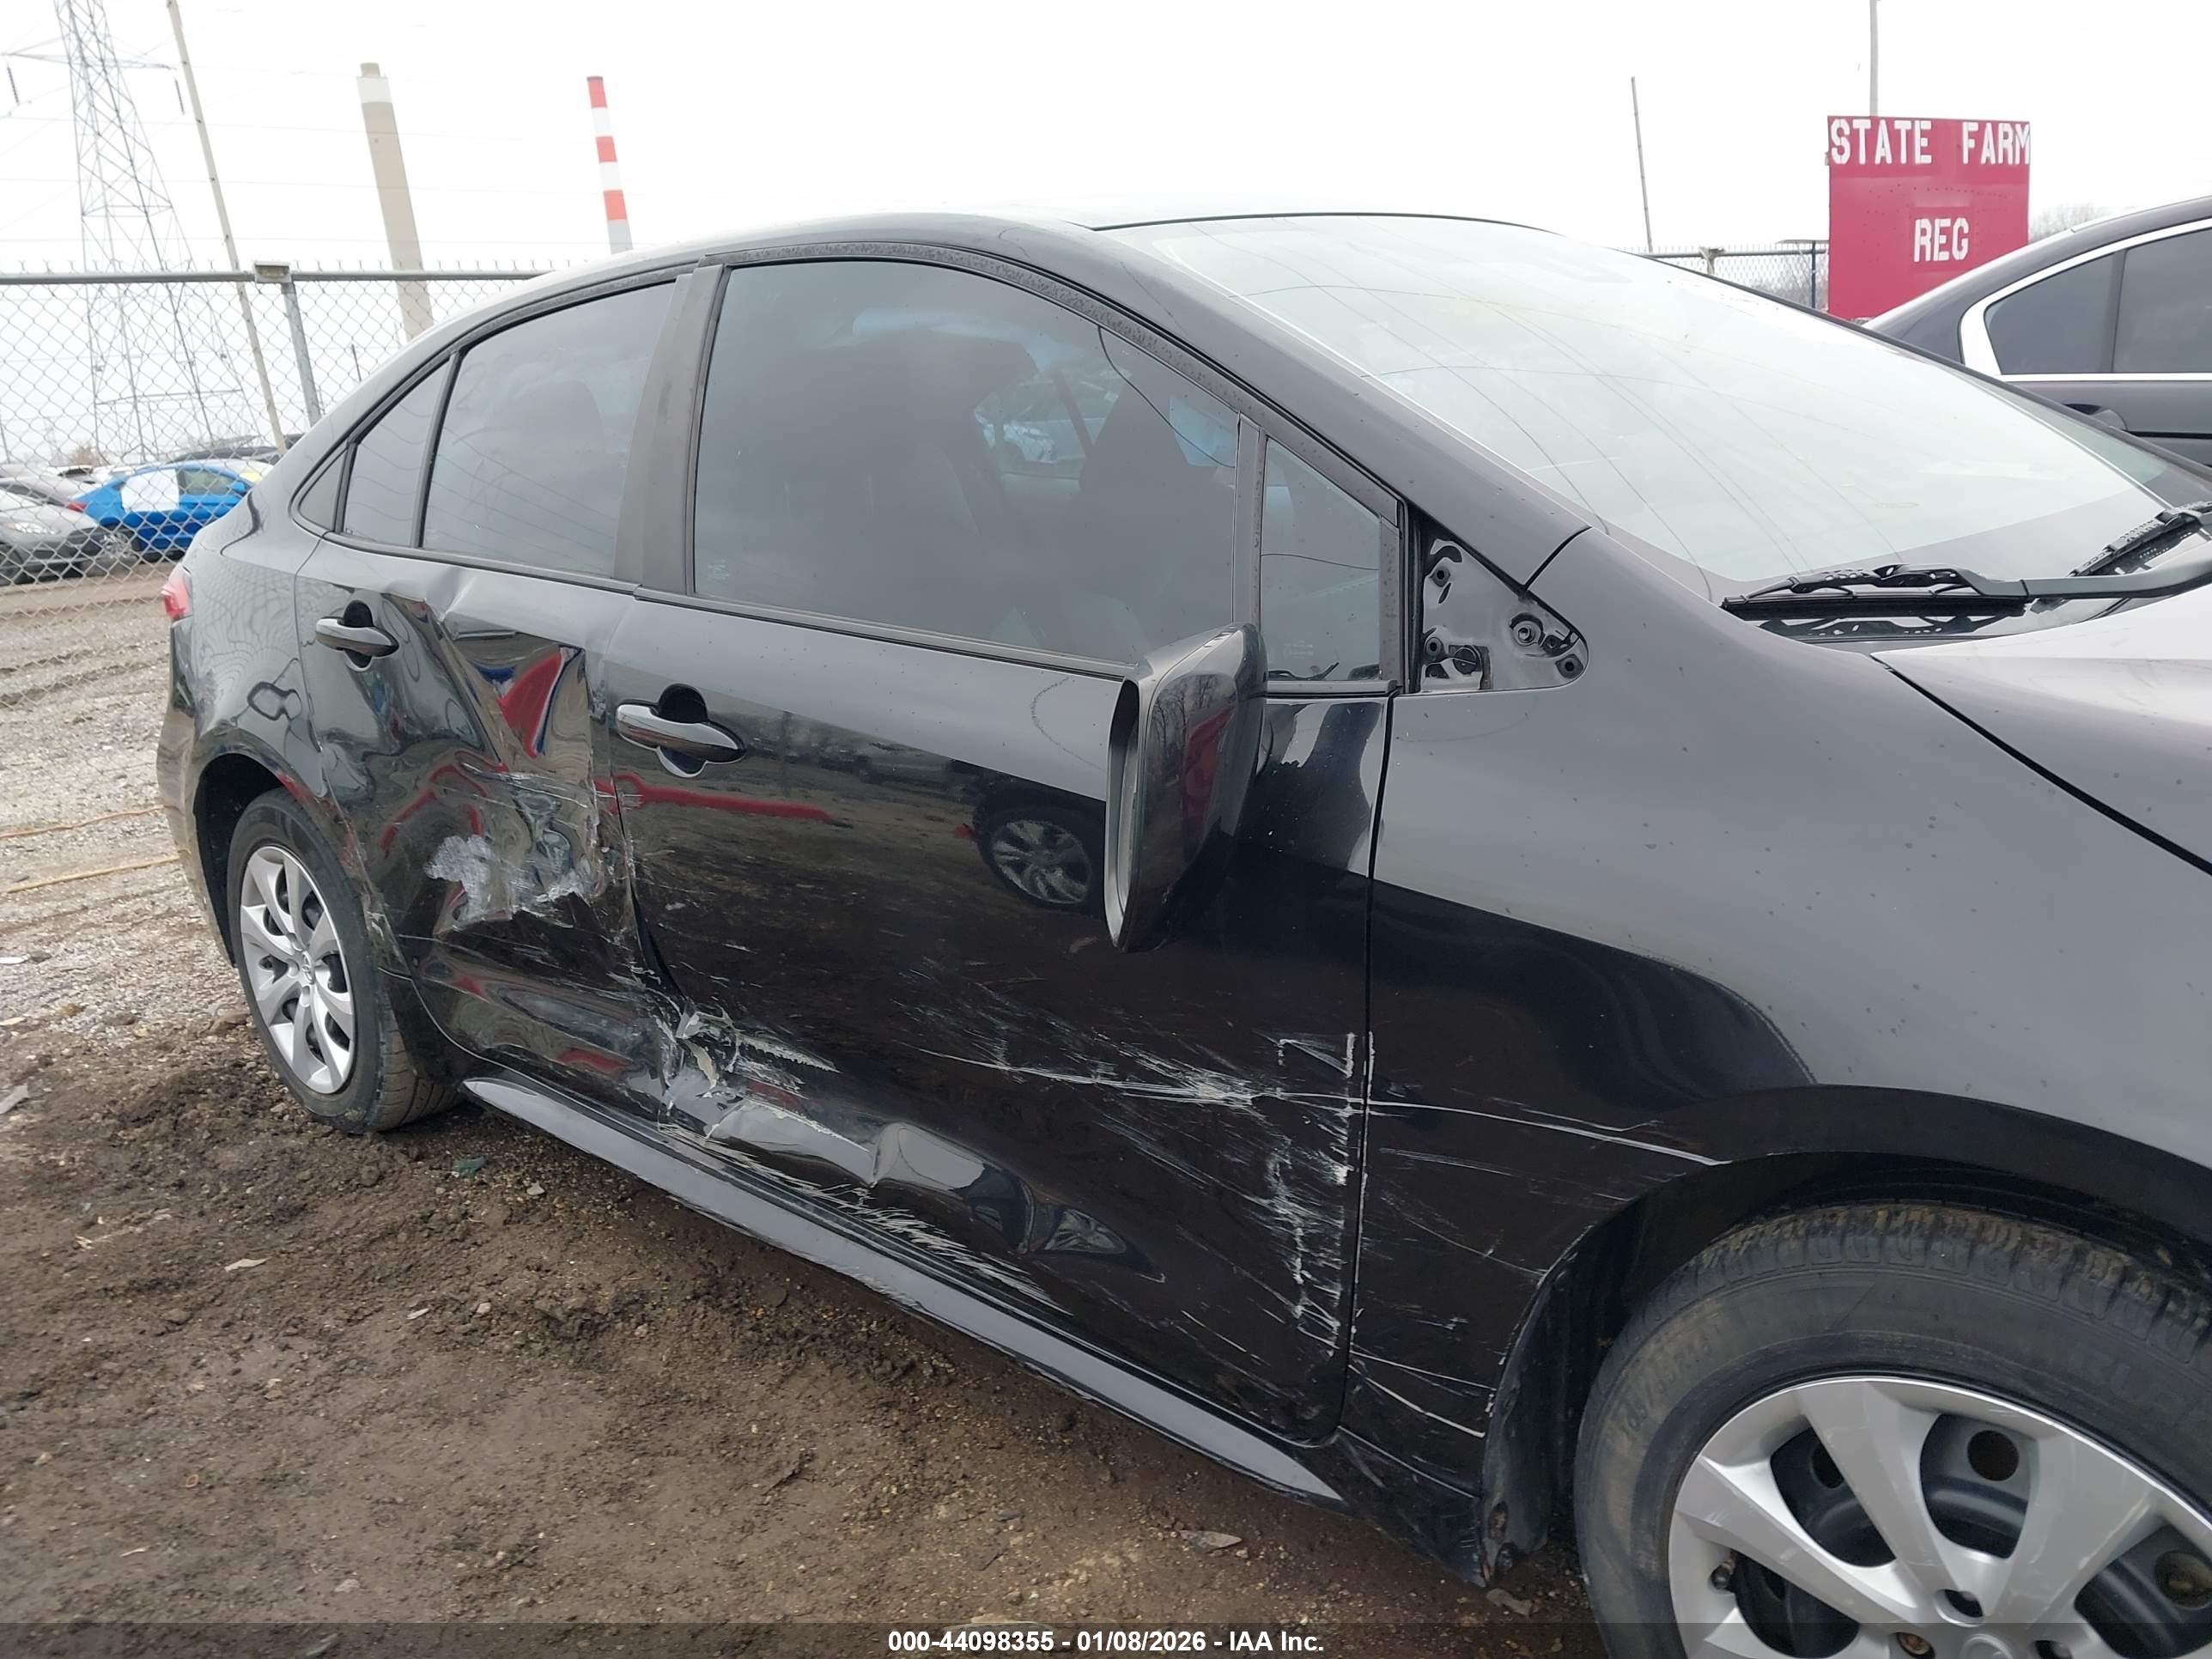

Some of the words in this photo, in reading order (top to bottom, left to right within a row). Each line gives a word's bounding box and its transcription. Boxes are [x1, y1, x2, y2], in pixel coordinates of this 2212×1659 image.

[1830, 118, 1932, 165] STATE
[1961, 121, 2031, 165] FARM
[1913, 217, 1970, 262] REG
